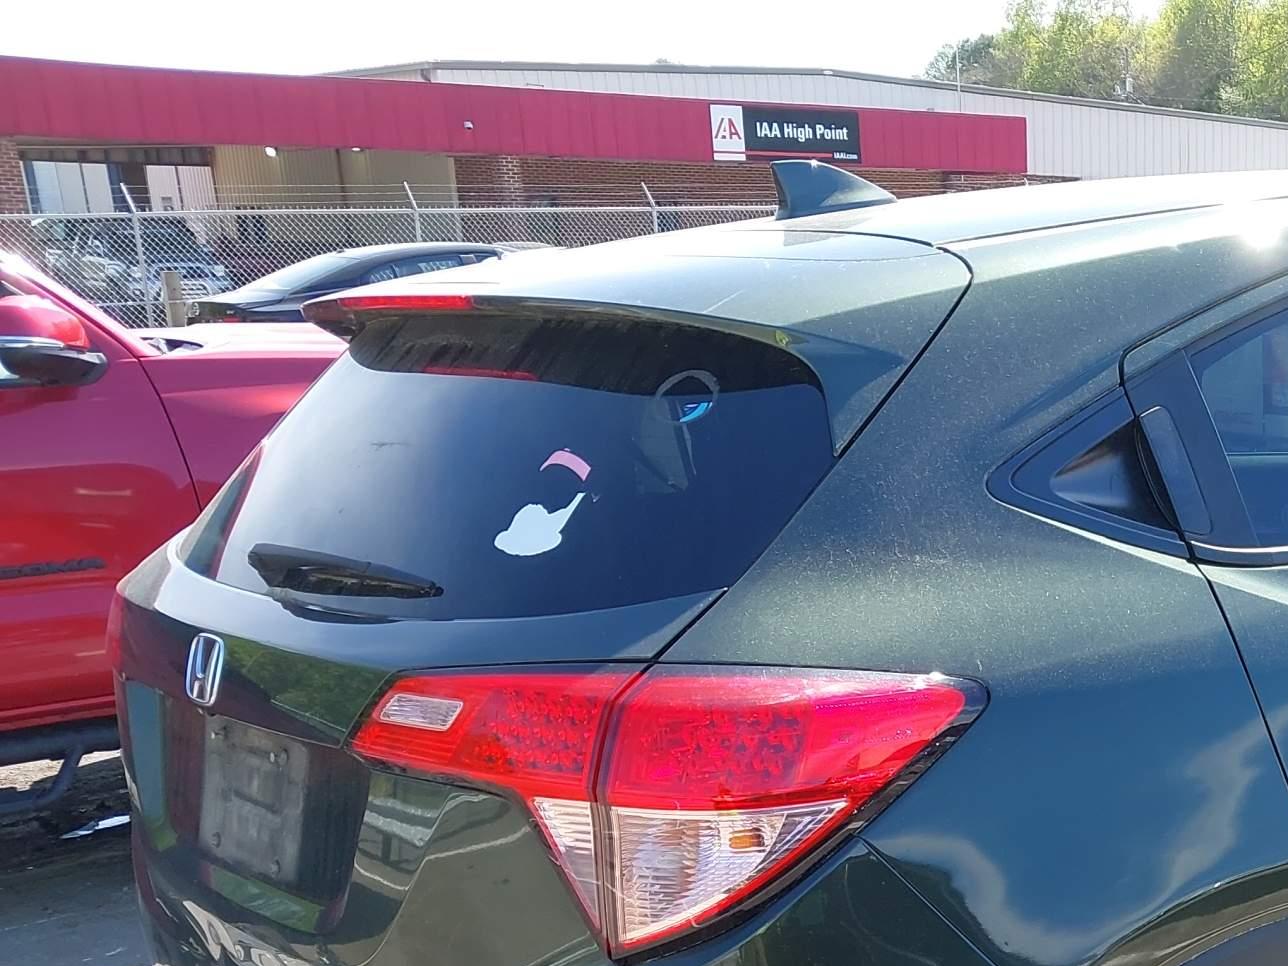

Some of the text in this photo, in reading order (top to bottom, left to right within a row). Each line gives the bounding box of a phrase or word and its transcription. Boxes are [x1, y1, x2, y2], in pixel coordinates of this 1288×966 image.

[755, 122, 849, 142] IAA High Point
